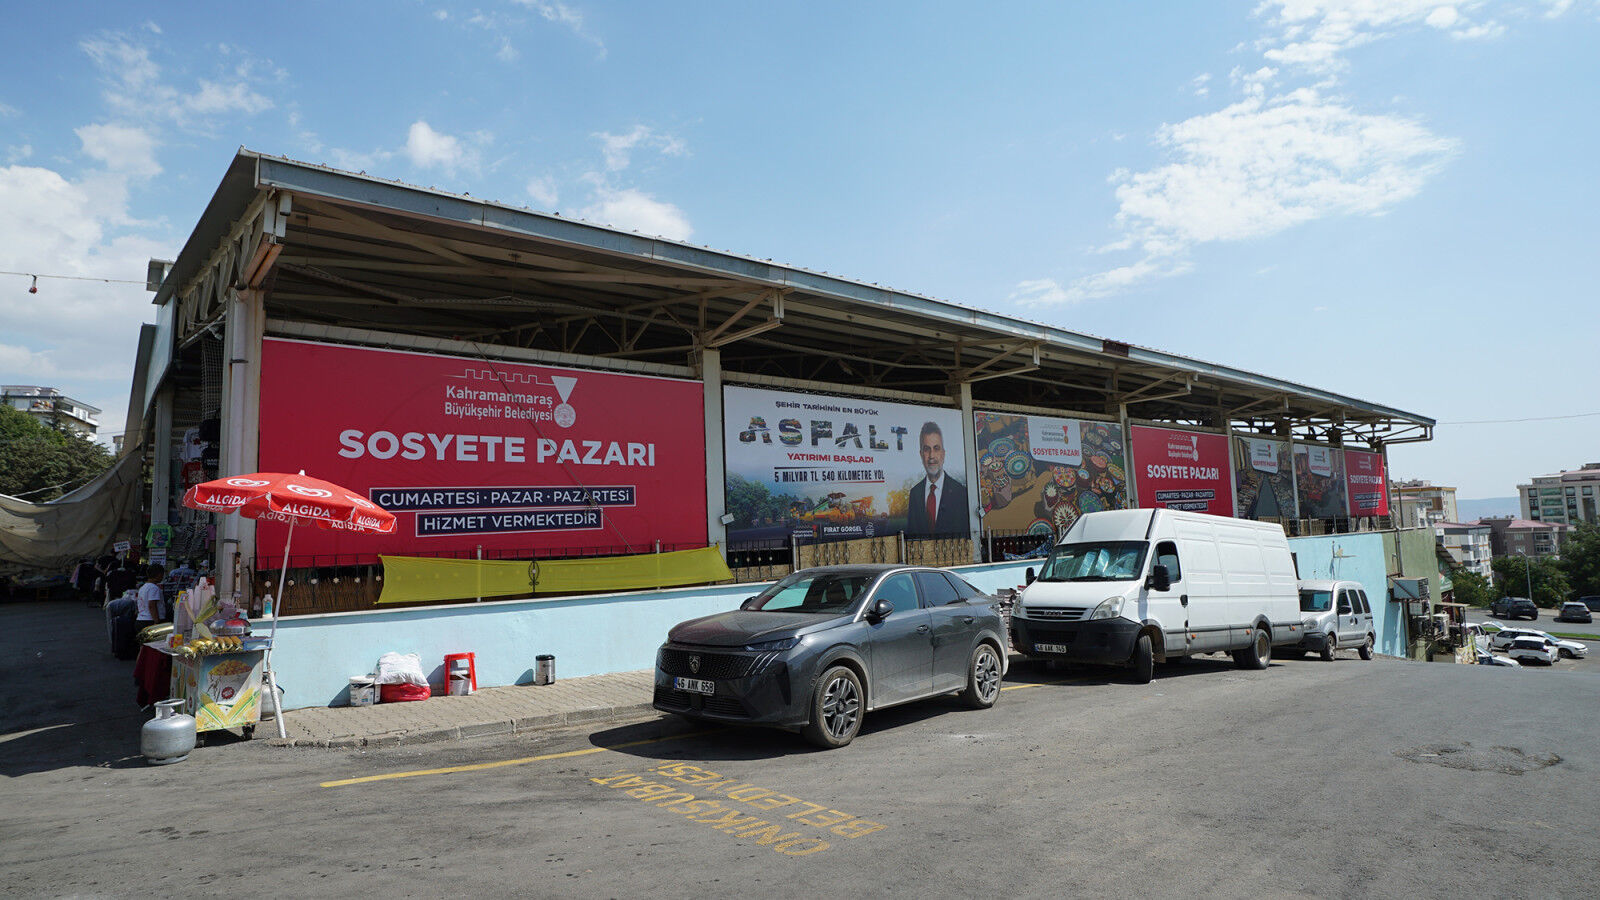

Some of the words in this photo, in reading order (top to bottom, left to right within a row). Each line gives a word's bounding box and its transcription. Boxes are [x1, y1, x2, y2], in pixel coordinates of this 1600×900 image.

[446, 385, 553, 408] Kahramanmaraş
[445, 402, 502, 420] Büyükşehir
[504, 406, 553, 422] Belediyesi
[854, 407, 879, 416] BÜYÜK
[739, 416, 908, 451] ASFALT
[338, 429, 525, 462] SOSYETE
[537, 438, 655, 466] PAZARI
[1032, 448, 1059, 456] SOSYETE
[1060, 449, 1080, 457] PAZARI
[787, 453, 831, 462] YATIRIMI
[833, 454, 874, 464] BAŞLADI
[774, 472, 779, 482] 5
[811, 471, 818, 481] TL
[822, 470, 835, 481] 540
[874, 469, 885, 480] YOL
[1147, 464, 1189, 479] SOSYETE
[1190, 467, 1219, 480] PAZARI
[491, 491, 543, 504] PAZAR
